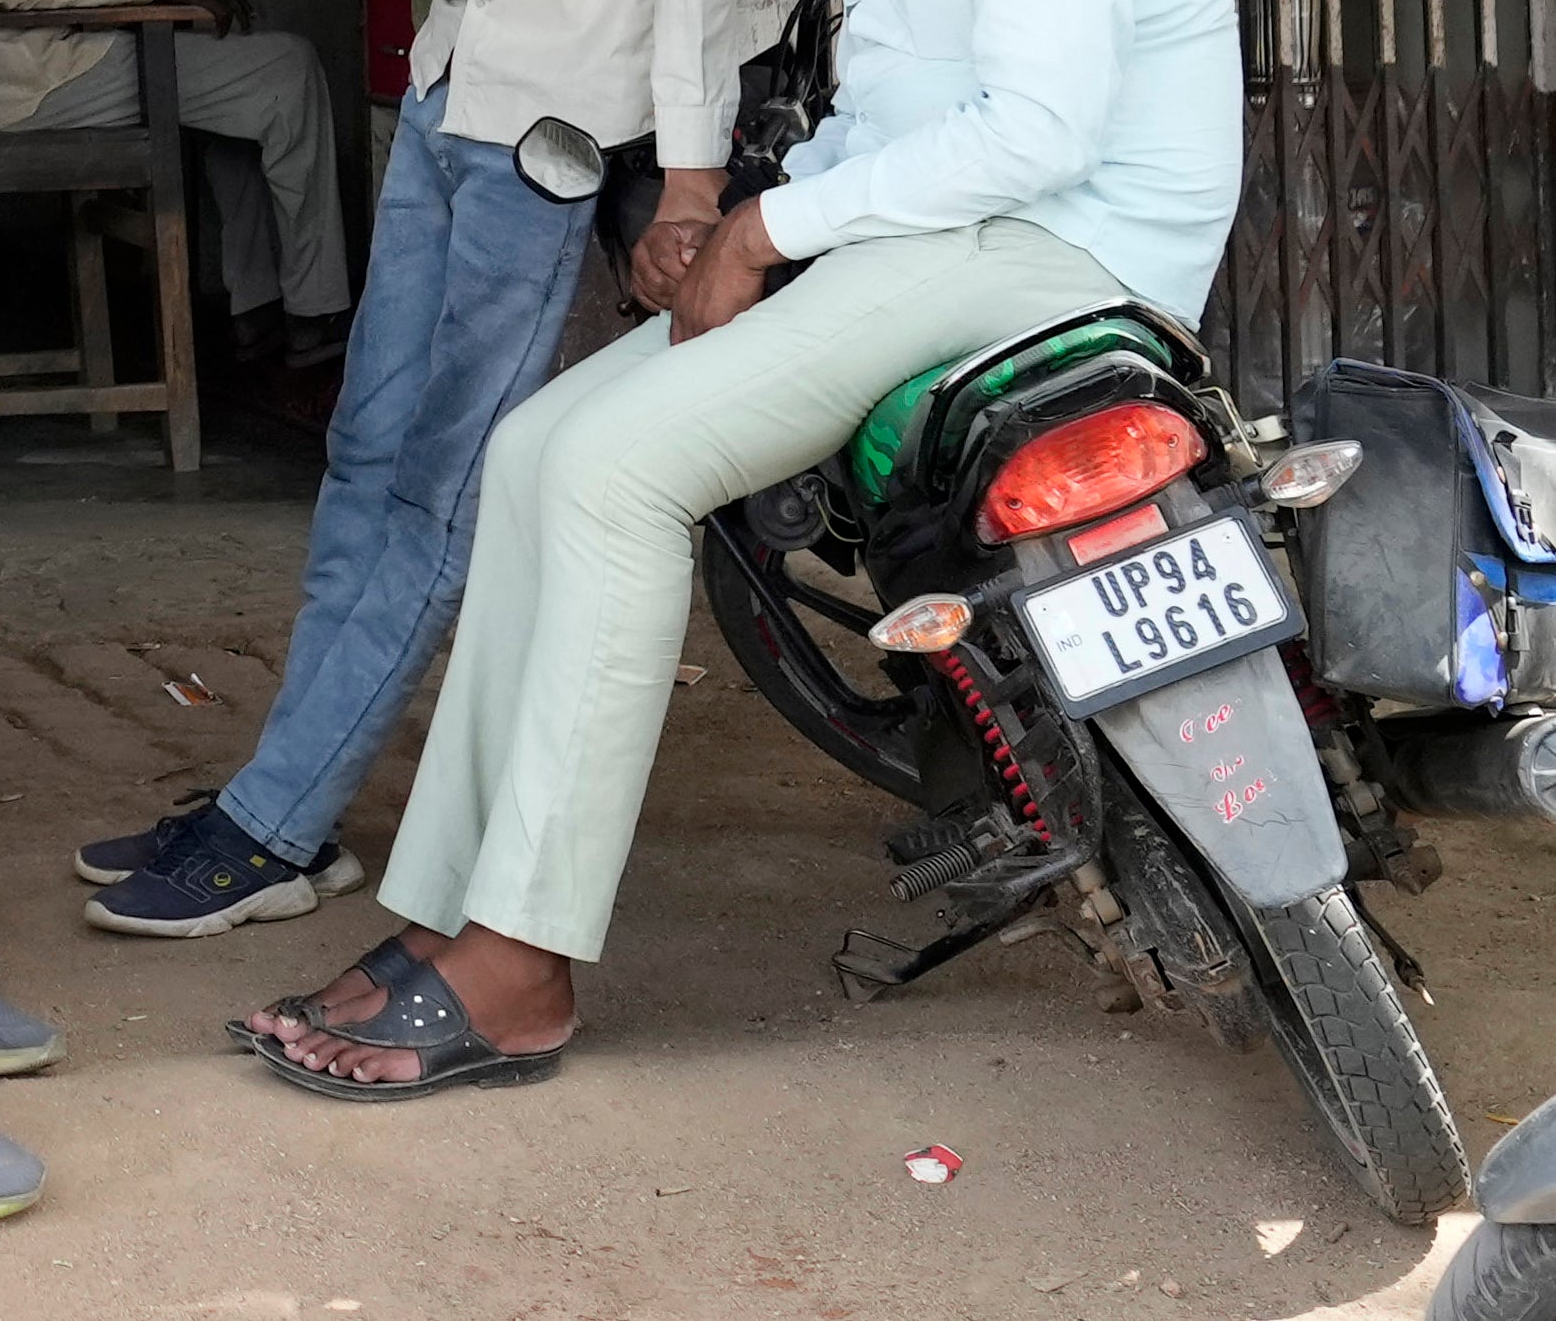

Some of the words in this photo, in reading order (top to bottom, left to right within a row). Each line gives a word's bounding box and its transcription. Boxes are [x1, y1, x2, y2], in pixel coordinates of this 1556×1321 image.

[1092, 538, 1217, 617] UP94
[1056, 633, 1083, 652] IND
[1102, 583, 1258, 674] L9616
